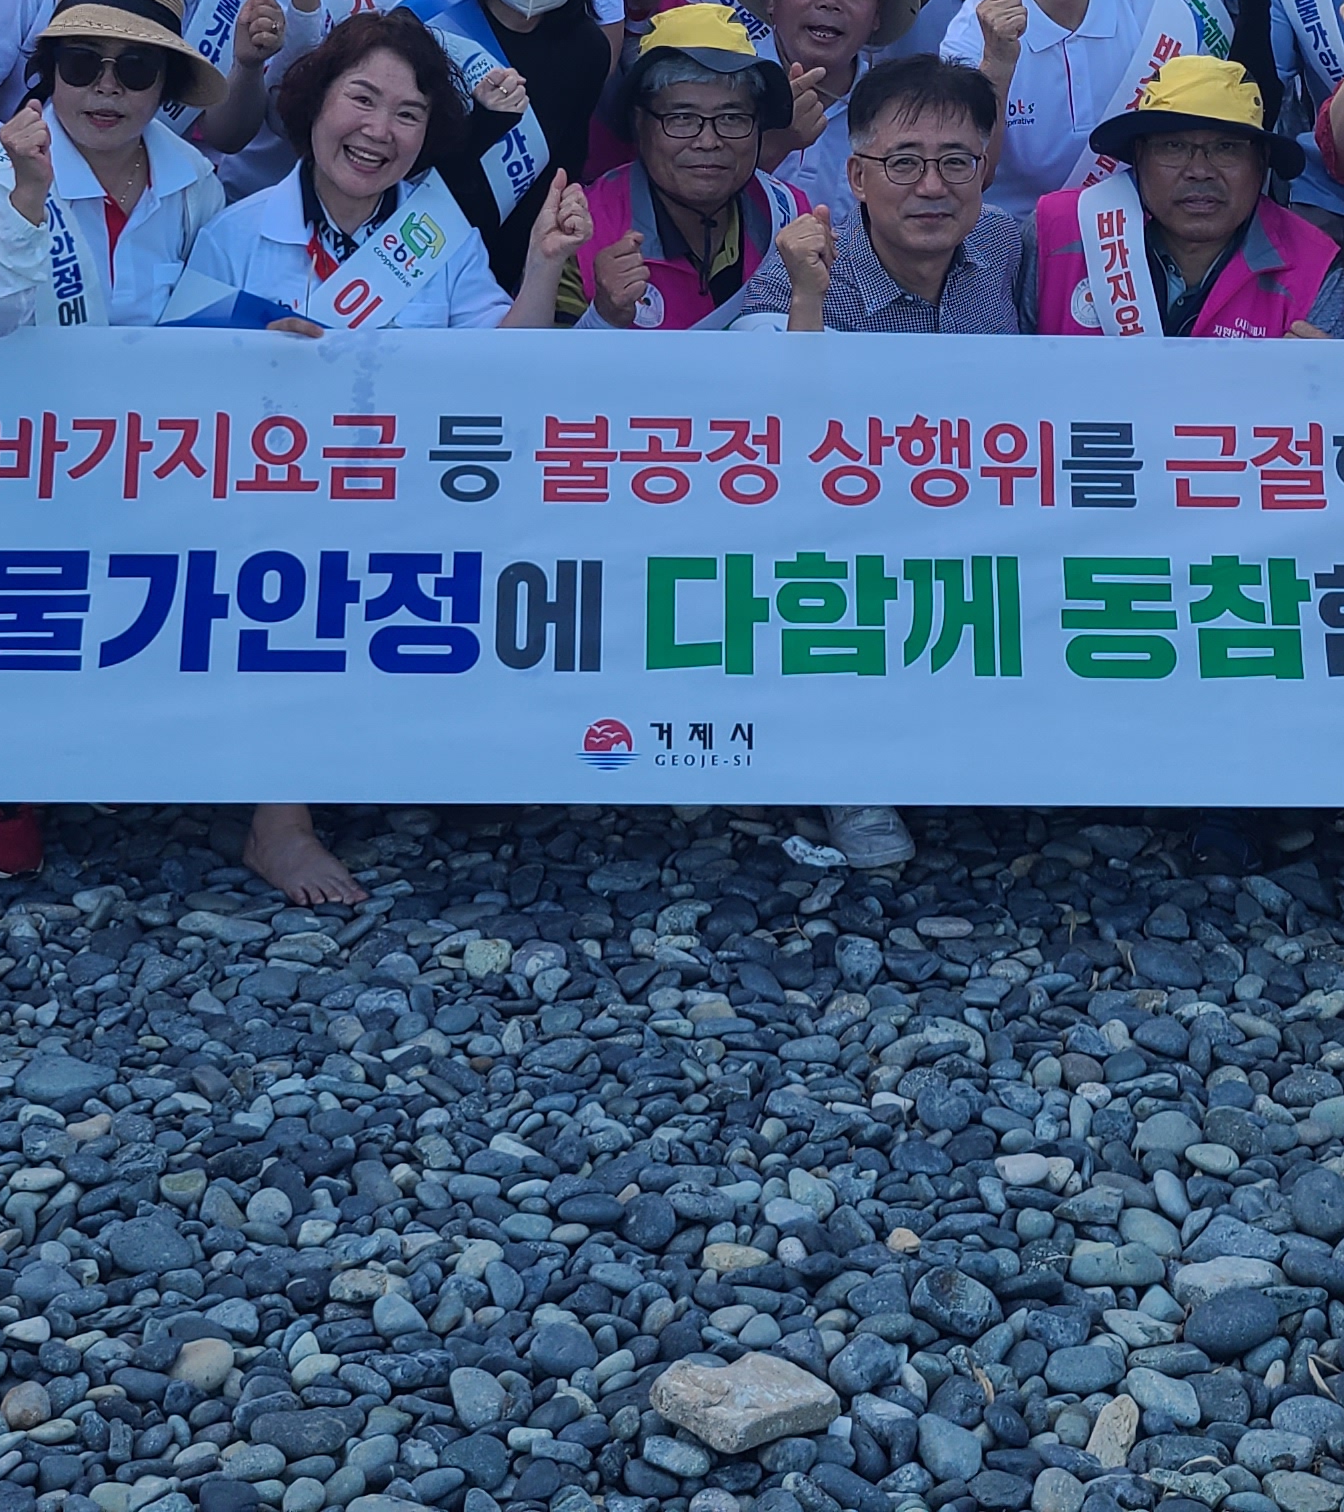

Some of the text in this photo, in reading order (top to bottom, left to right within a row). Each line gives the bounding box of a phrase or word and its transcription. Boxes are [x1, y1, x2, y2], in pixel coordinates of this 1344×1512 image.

[372, 245, 413, 289] cooperative
[382, 233, 424, 278] ebts
[429, 414, 512, 503] 등
[535, 414, 784, 505] 불공정
[807, 414, 1143, 511] 상행위를
[646, 551, 1025, 681] 다함께
[650, 723, 754, 751] 거제시
[655, 754, 751, 769] GEOJE-SI
